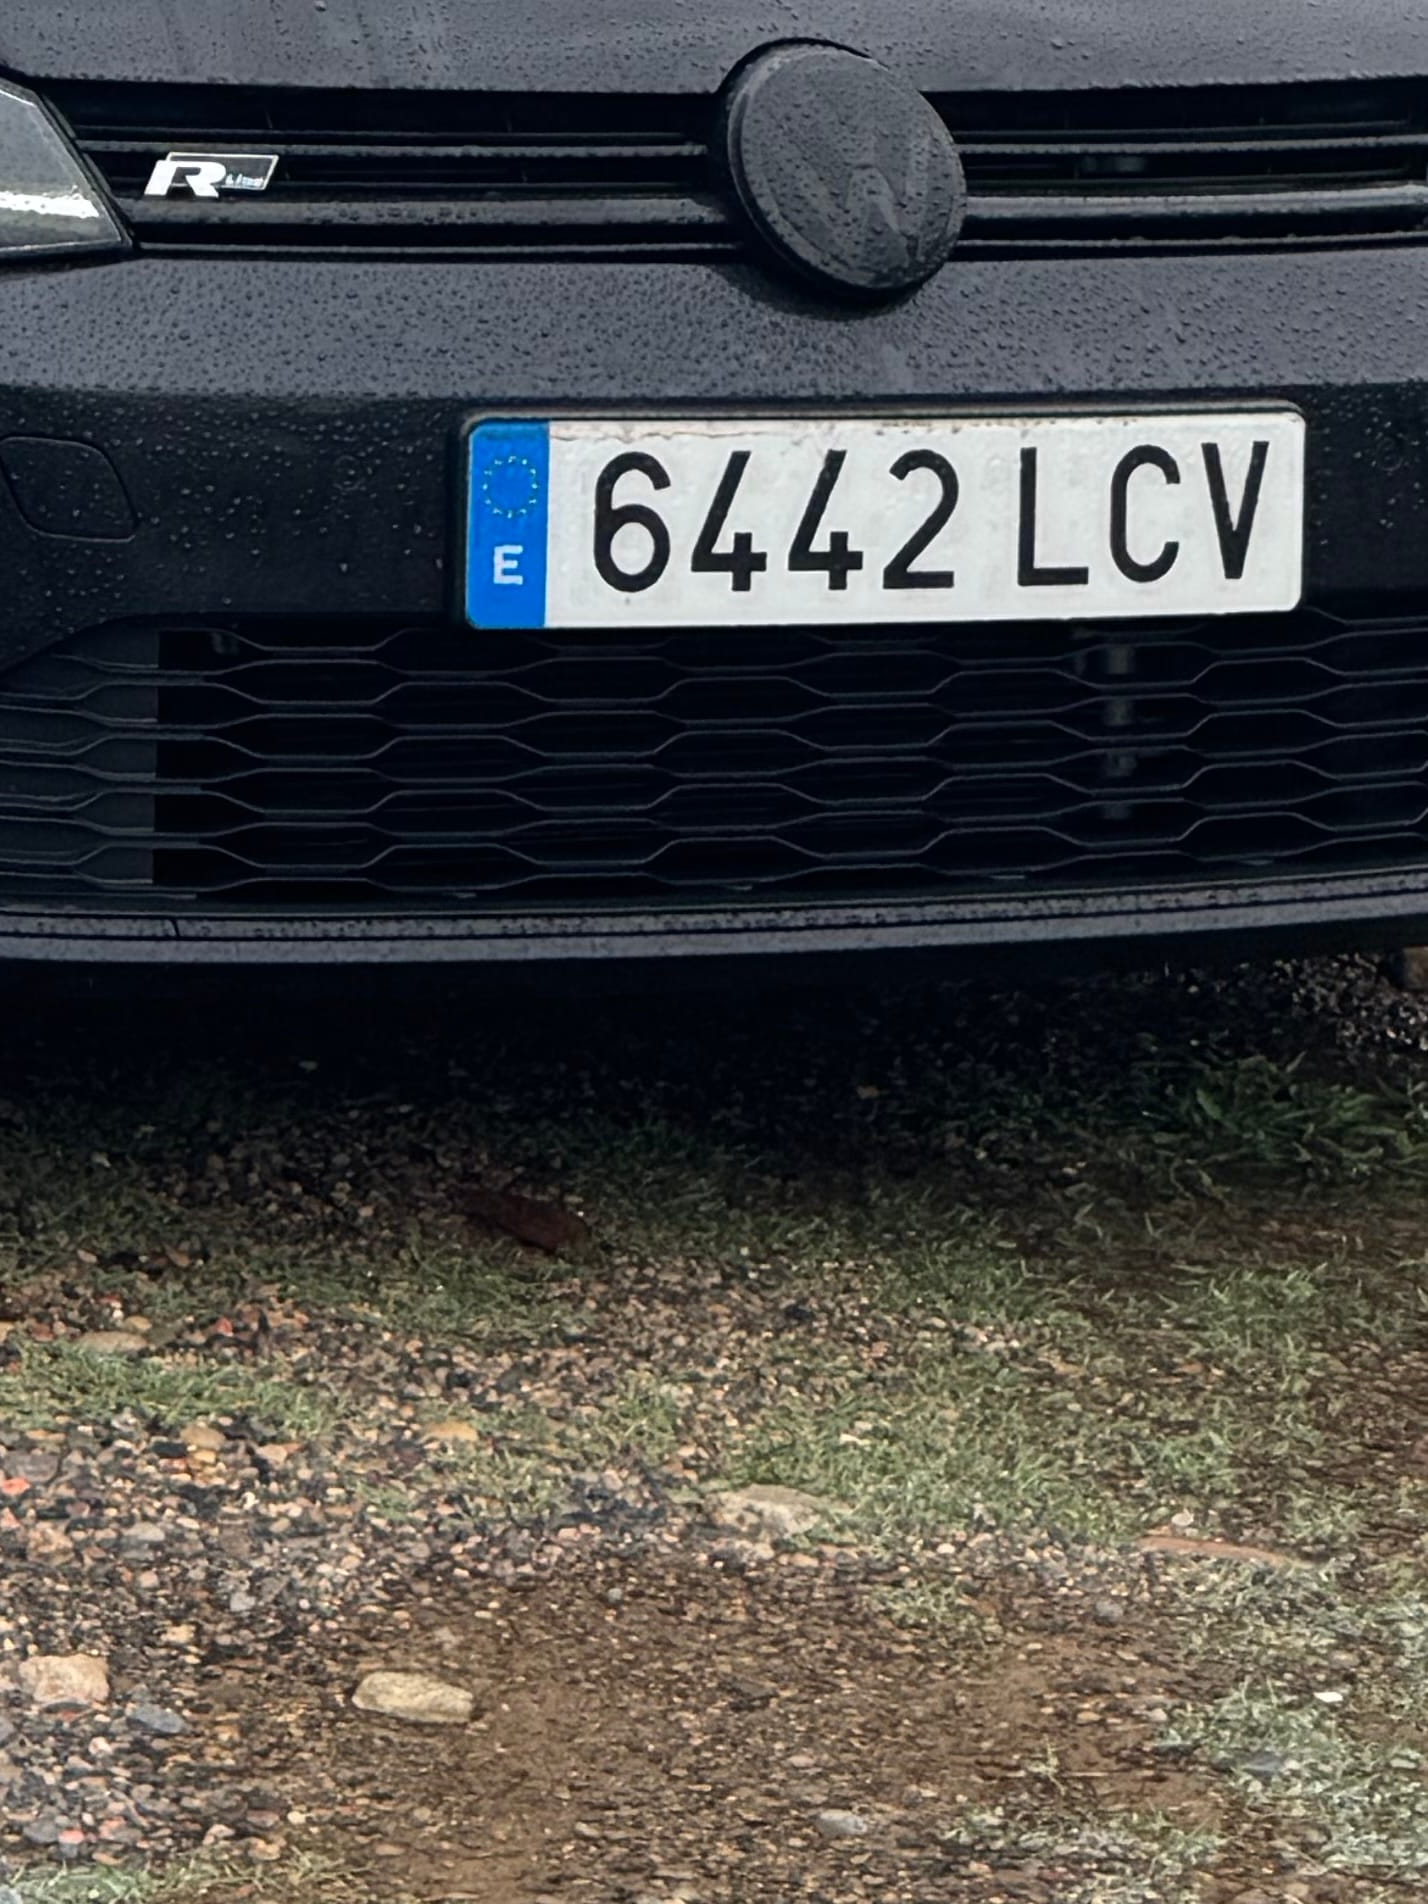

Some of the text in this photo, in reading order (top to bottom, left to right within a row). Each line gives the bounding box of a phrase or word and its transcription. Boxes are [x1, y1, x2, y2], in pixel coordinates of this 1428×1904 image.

[143, 159, 227, 198] R
[592, 440, 1270, 593] 6442 LCV
[493, 544, 524, 586] E
